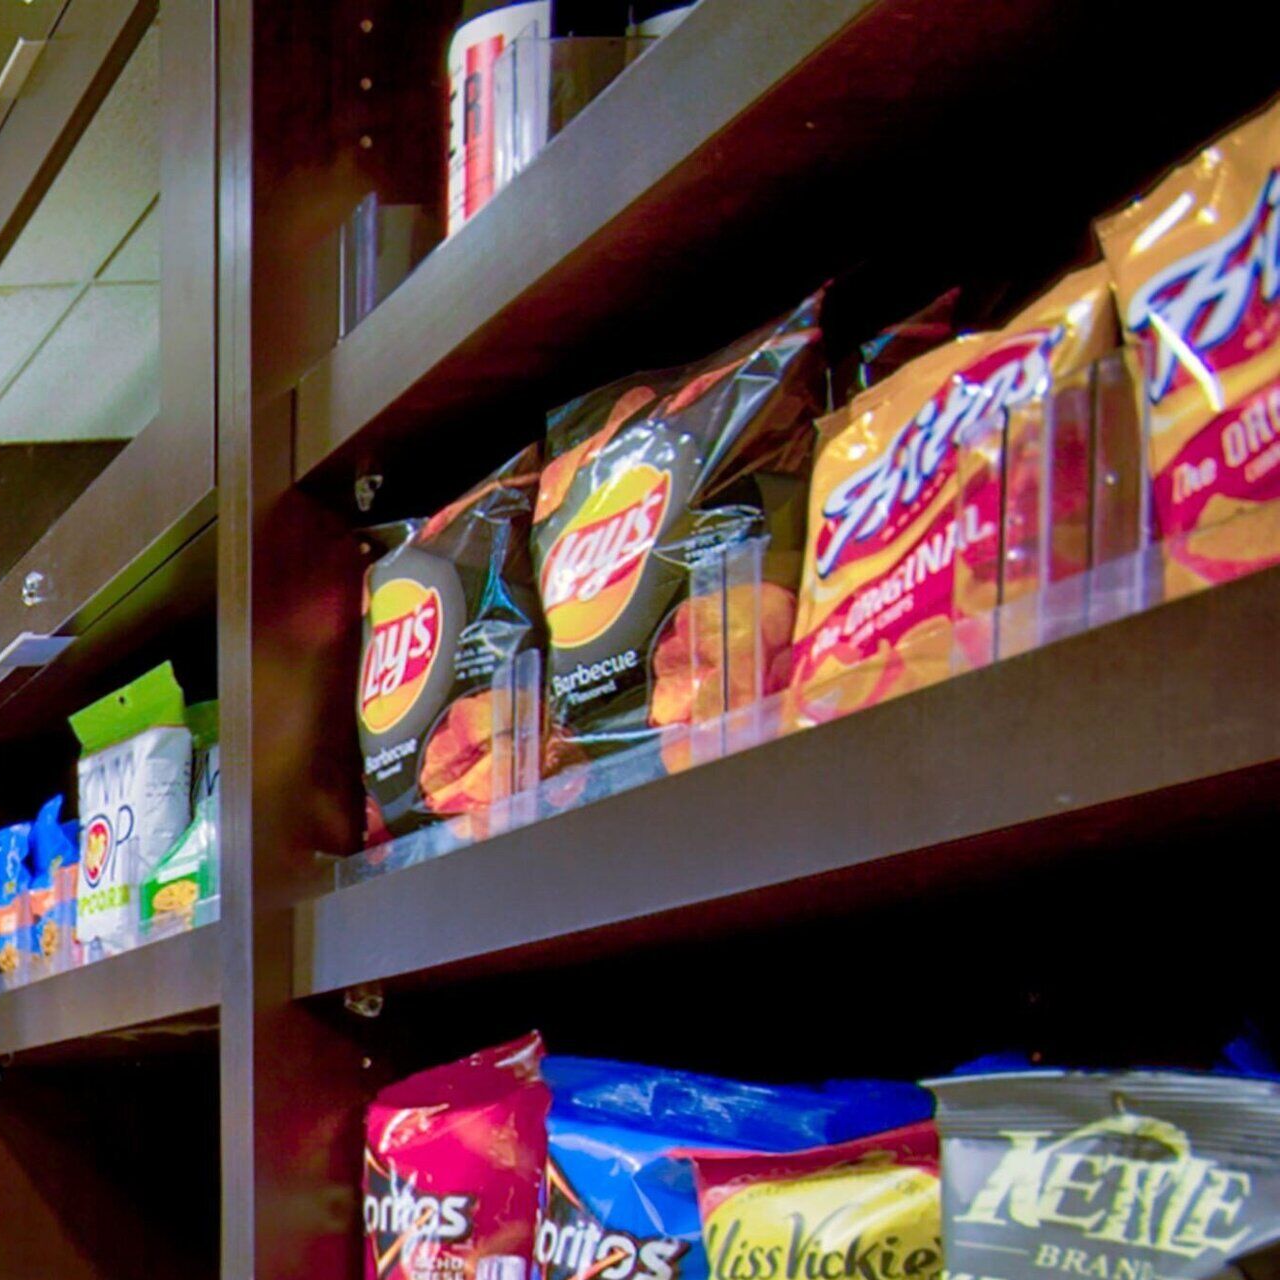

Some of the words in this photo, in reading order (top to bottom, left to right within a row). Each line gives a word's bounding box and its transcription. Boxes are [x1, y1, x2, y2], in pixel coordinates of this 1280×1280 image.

[822, 324, 1065, 580] Fritos
[543, 492, 663, 612] Lay's
[844, 504, 995, 634] ORIGINAL
[363, 605, 434, 699] Lay's
[553, 650, 638, 696] Barbecue
[364, 1194, 469, 1237] oritos
[954, 1127, 1254, 1257] KETTLE
